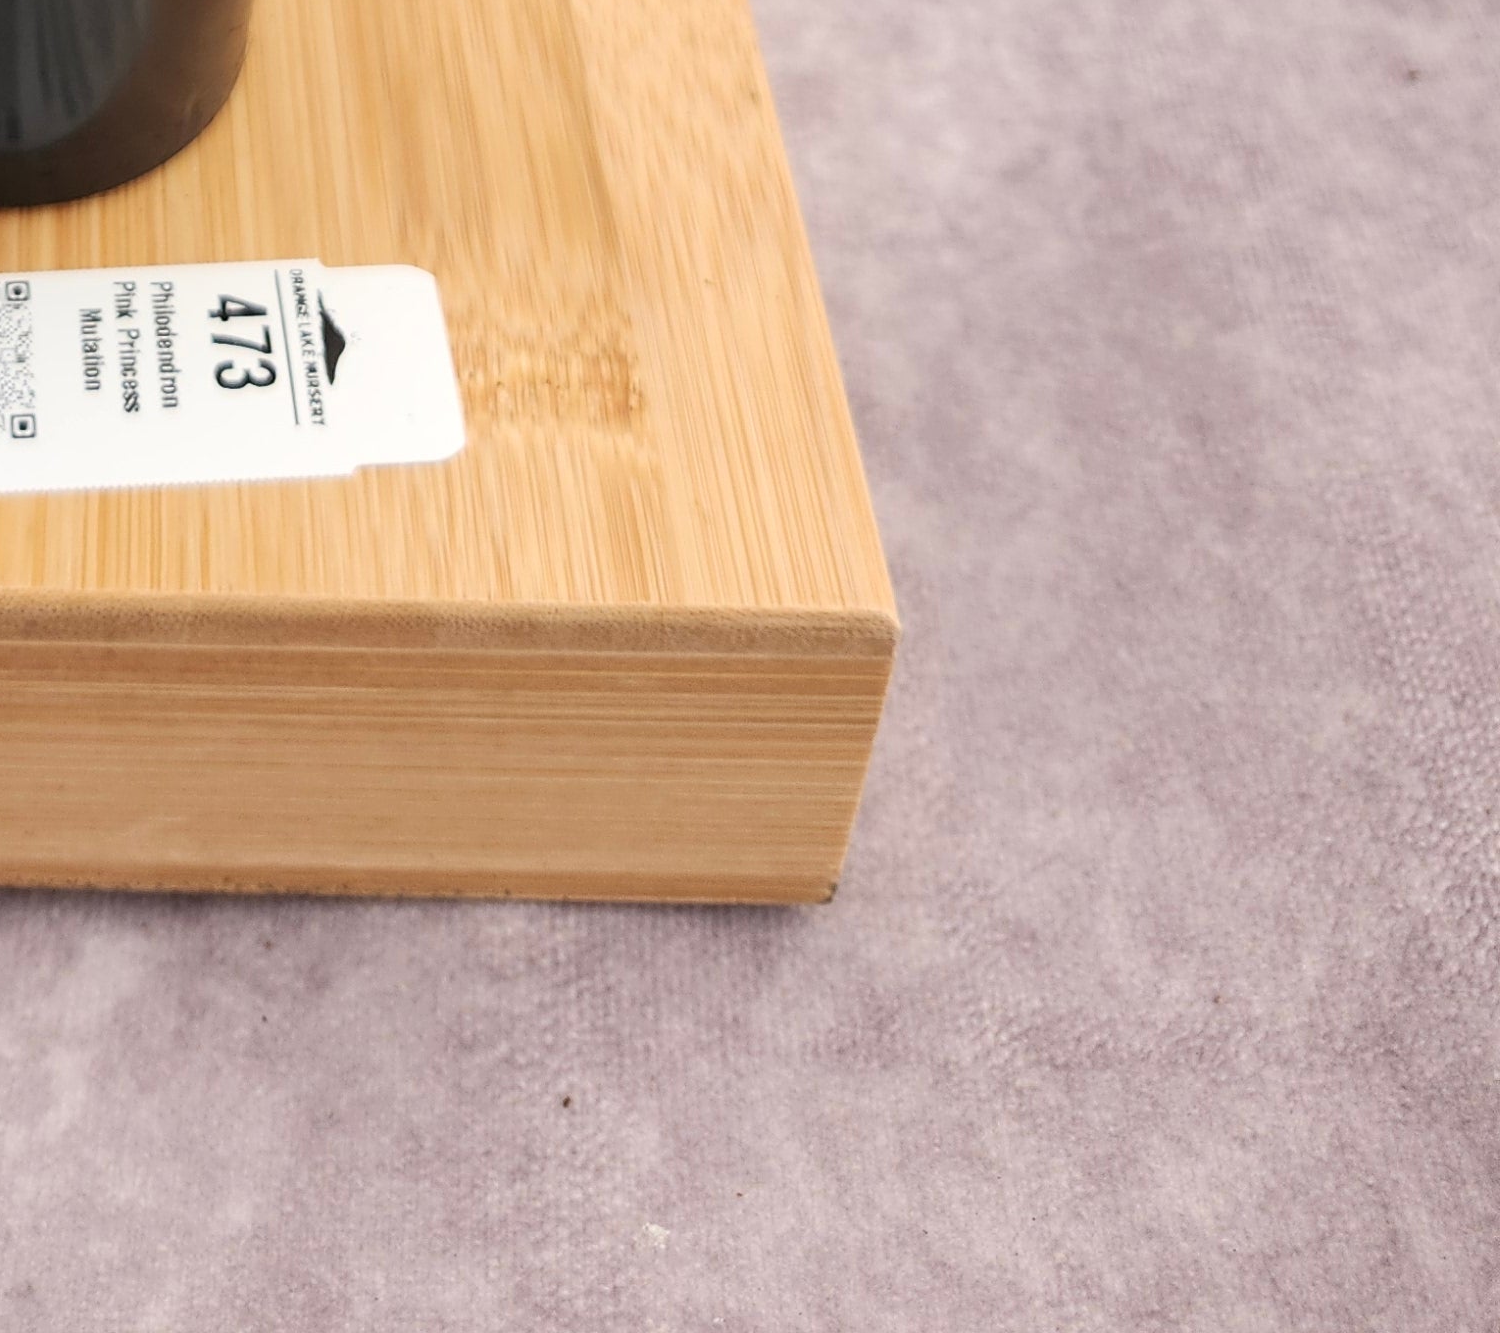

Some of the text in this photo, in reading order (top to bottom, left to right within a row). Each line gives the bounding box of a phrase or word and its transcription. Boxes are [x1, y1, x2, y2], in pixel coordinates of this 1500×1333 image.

[79, 308, 105, 391] Mutation
[113, 280, 141, 413] Pink Princess
[150, 281, 182, 408] Philodendron
[207, 293, 277, 390] 473
[298, 322, 315, 357] LAKE
